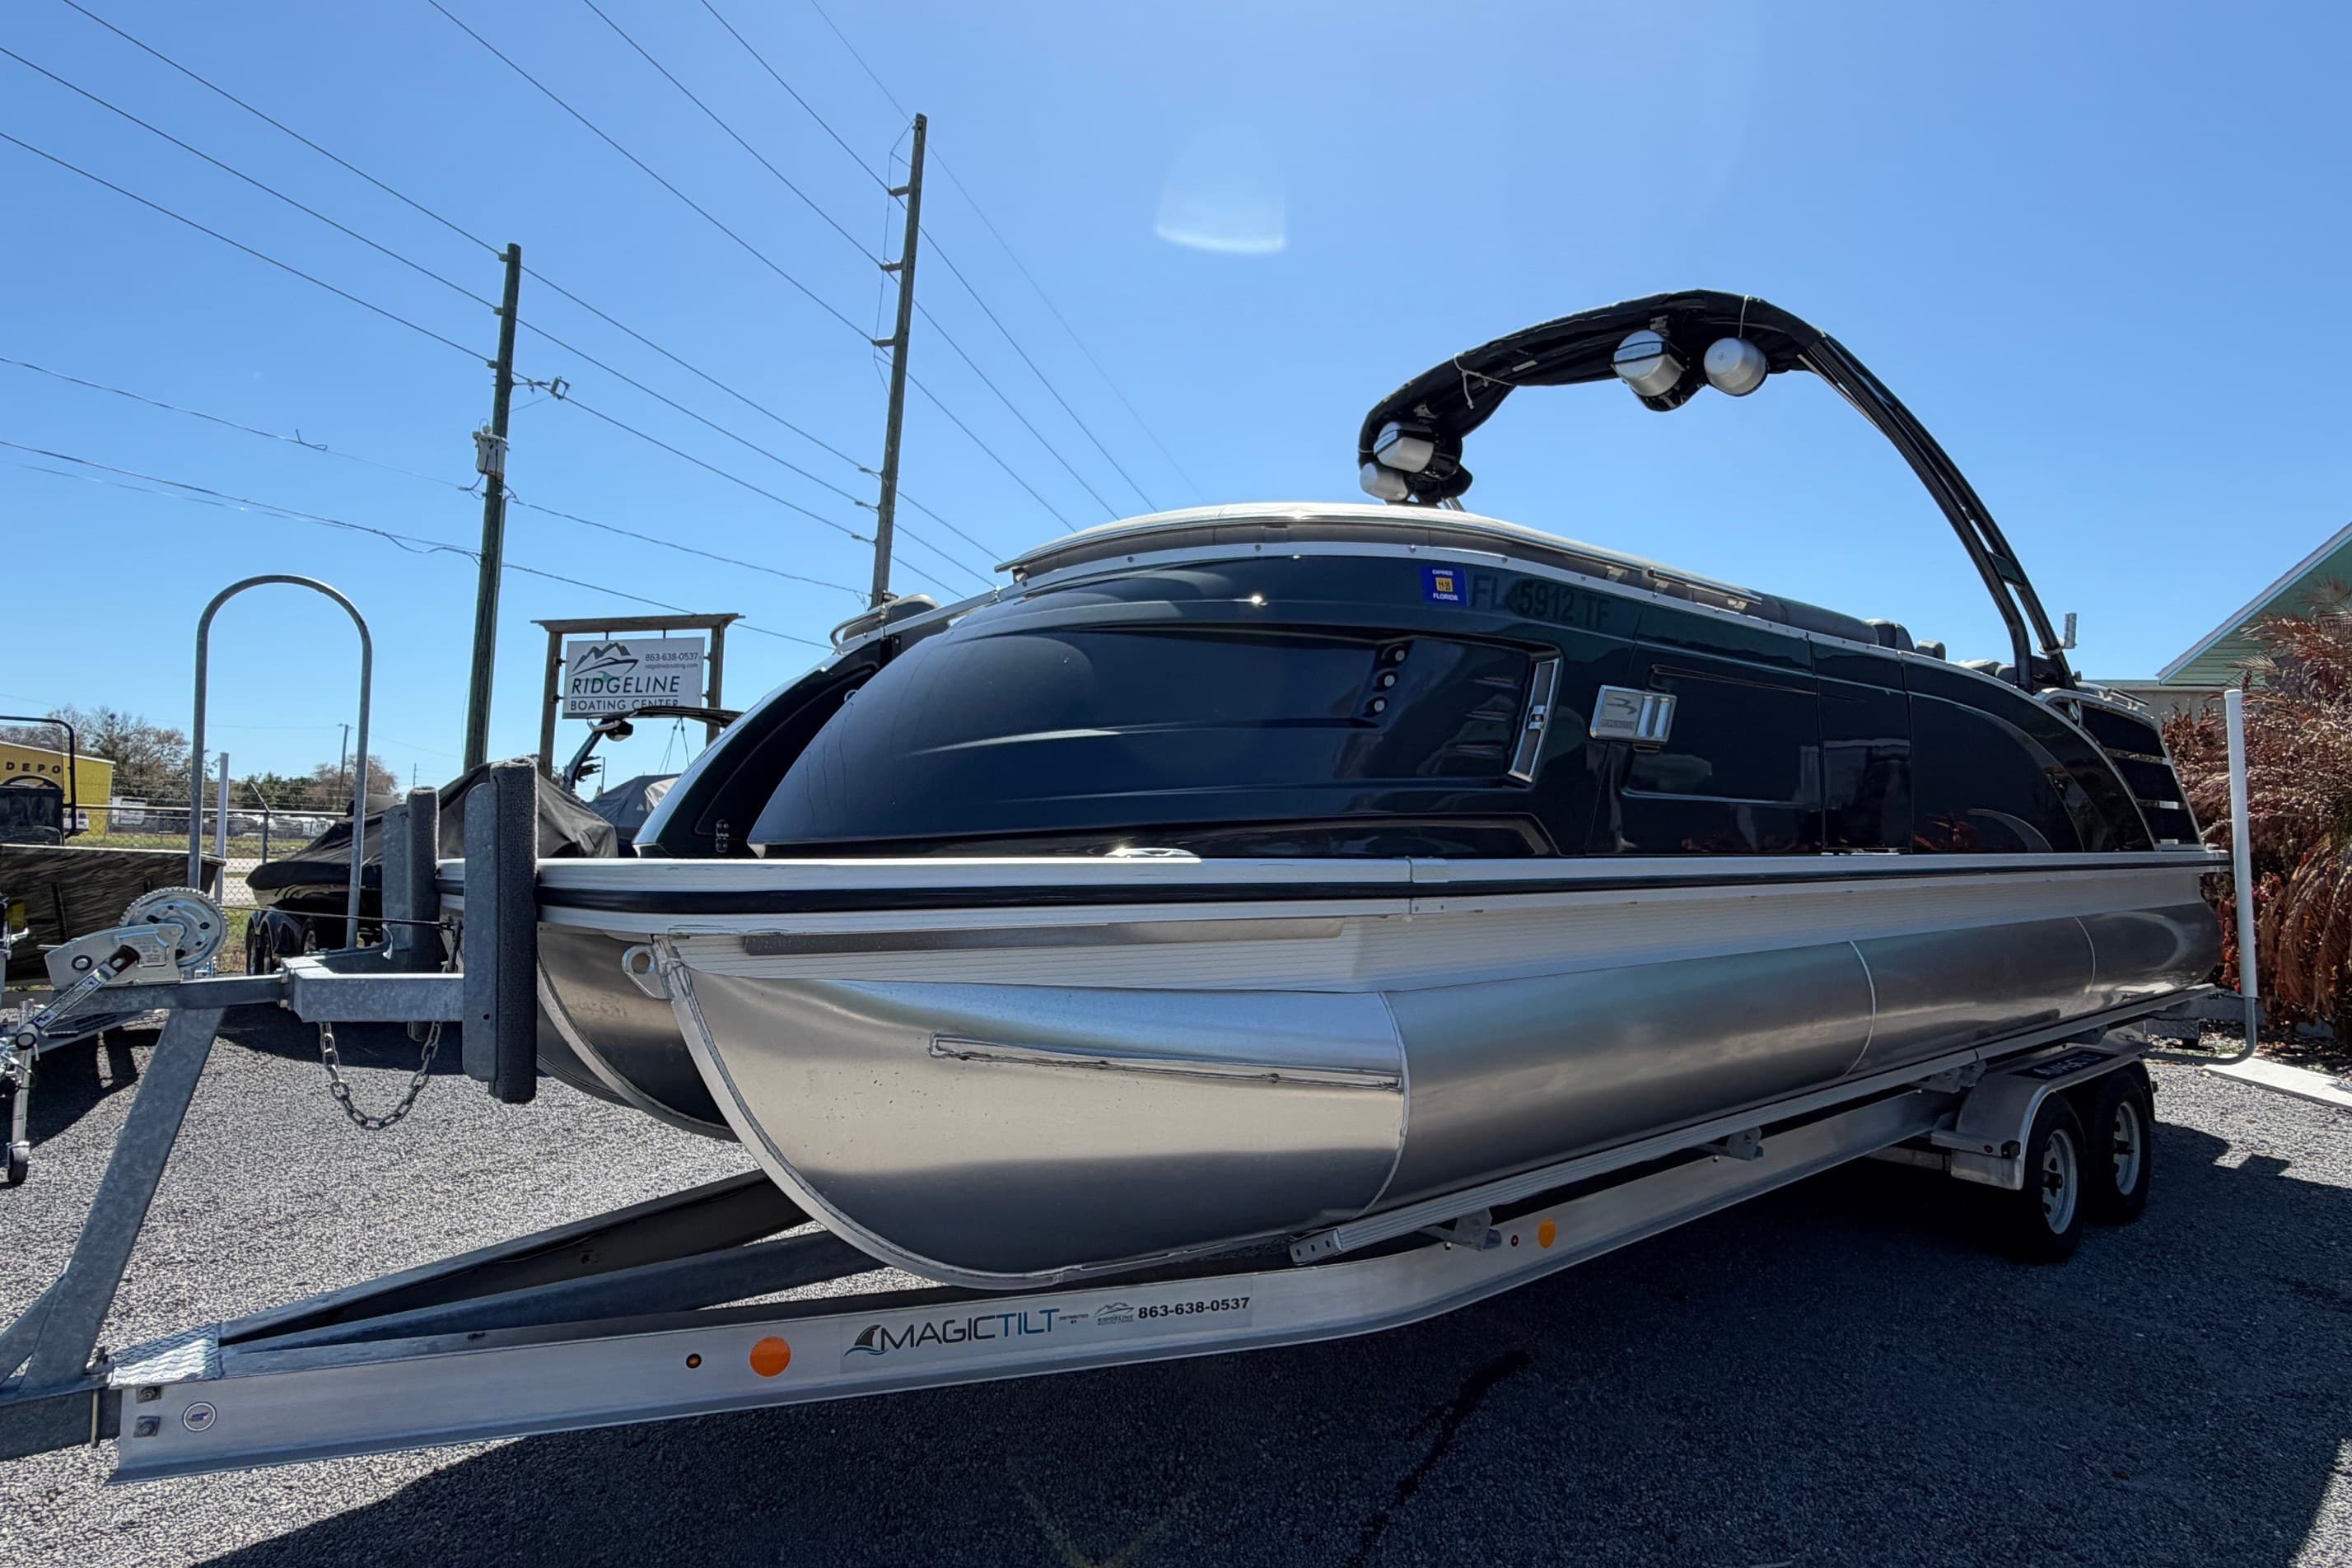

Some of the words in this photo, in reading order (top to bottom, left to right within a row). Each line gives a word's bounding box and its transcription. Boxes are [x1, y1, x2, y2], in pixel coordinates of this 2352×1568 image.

[1433, 592, 1458, 601] FLORIDA
[1471, 574, 1508, 611] FL
[1516, 579, 1575, 624] 5912
[1582, 591, 1611, 629] TF
[645, 652, 698, 661] 863-638-0537
[572, 675, 680, 694] RIDGELINE
[571, 699, 626, 711] BOATING
[632, 699, 679, 710] CENTER
[6, 762, 72, 774] DEPO
[1138, 1297, 1250, 1318] 863-638-0537
[880, 1308, 1061, 1351] MAGICTILT
